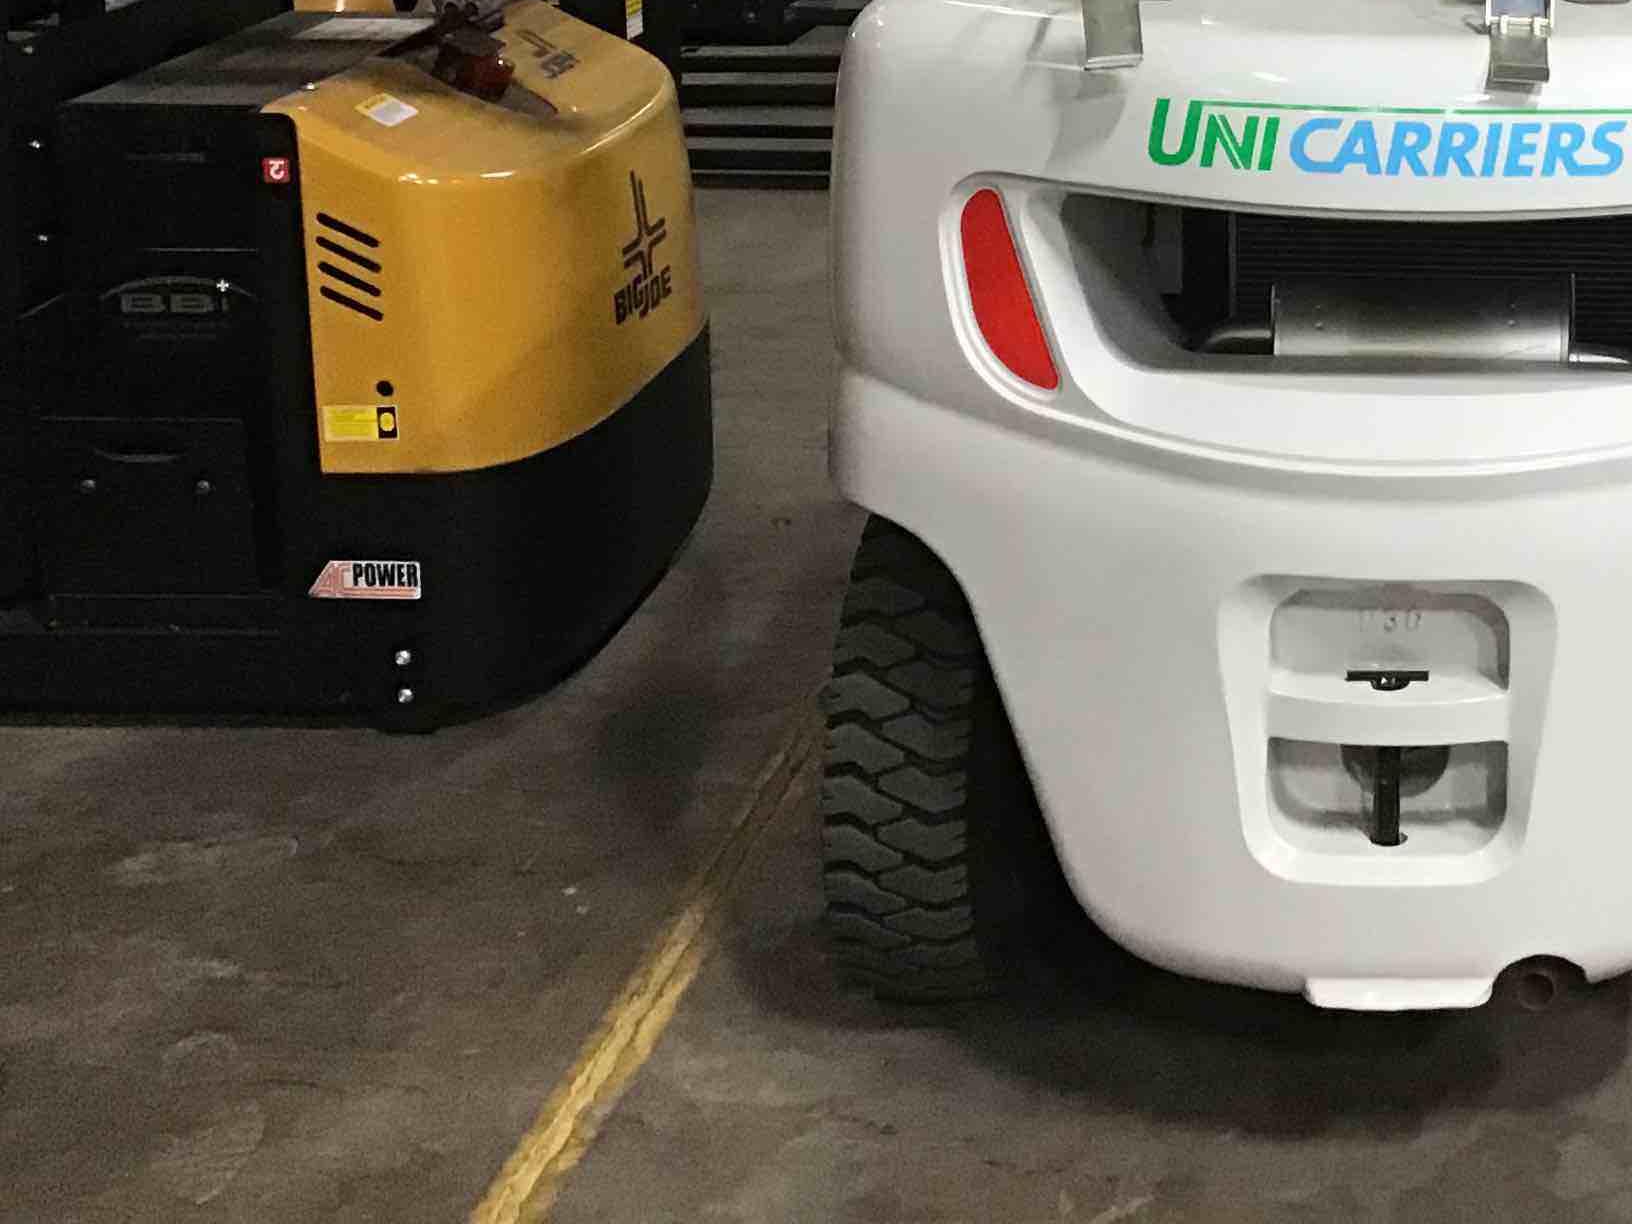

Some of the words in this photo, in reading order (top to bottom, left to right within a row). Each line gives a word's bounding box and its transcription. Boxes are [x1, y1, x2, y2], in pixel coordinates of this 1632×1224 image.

[613, 274, 644, 325] BIG
[639, 264, 673, 318] JOE
[352, 563, 418, 588] POWER
